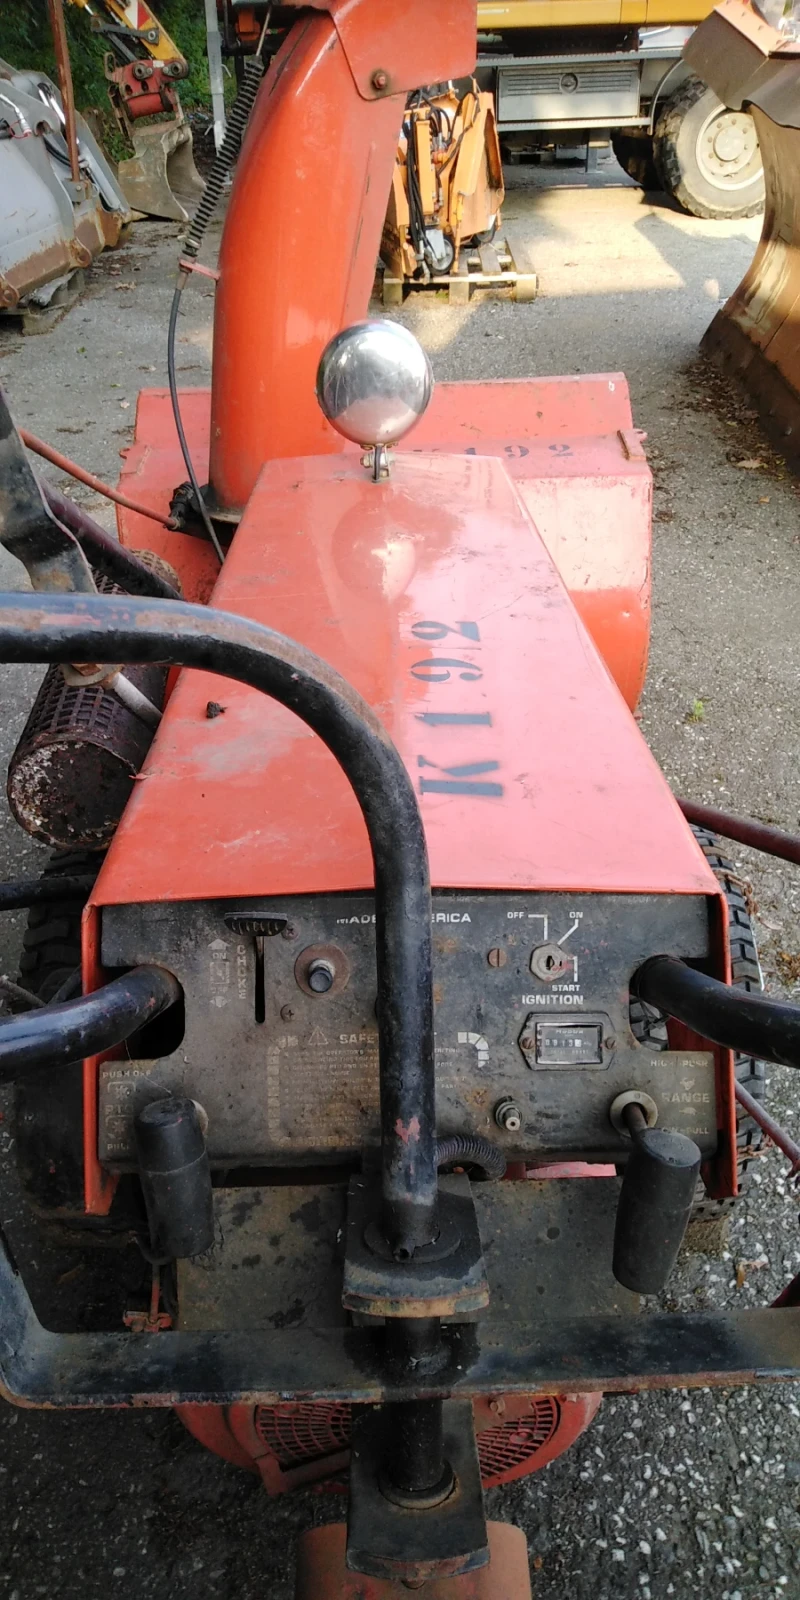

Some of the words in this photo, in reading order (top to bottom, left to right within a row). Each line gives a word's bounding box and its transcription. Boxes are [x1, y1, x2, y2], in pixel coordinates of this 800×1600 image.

[506, 911, 525, 919] OFF
[569, 911, 584, 919] ON
[212, 952, 227, 960] ON
[236, 944, 247, 999] CHOKE
[551, 984, 581, 992] START
[521, 994, 584, 1006] IGNITION
[339, 1033, 380, 1044] SAFE
[102, 1071, 130, 1079] PUSH
[661, 1092, 710, 1103] RANGE
